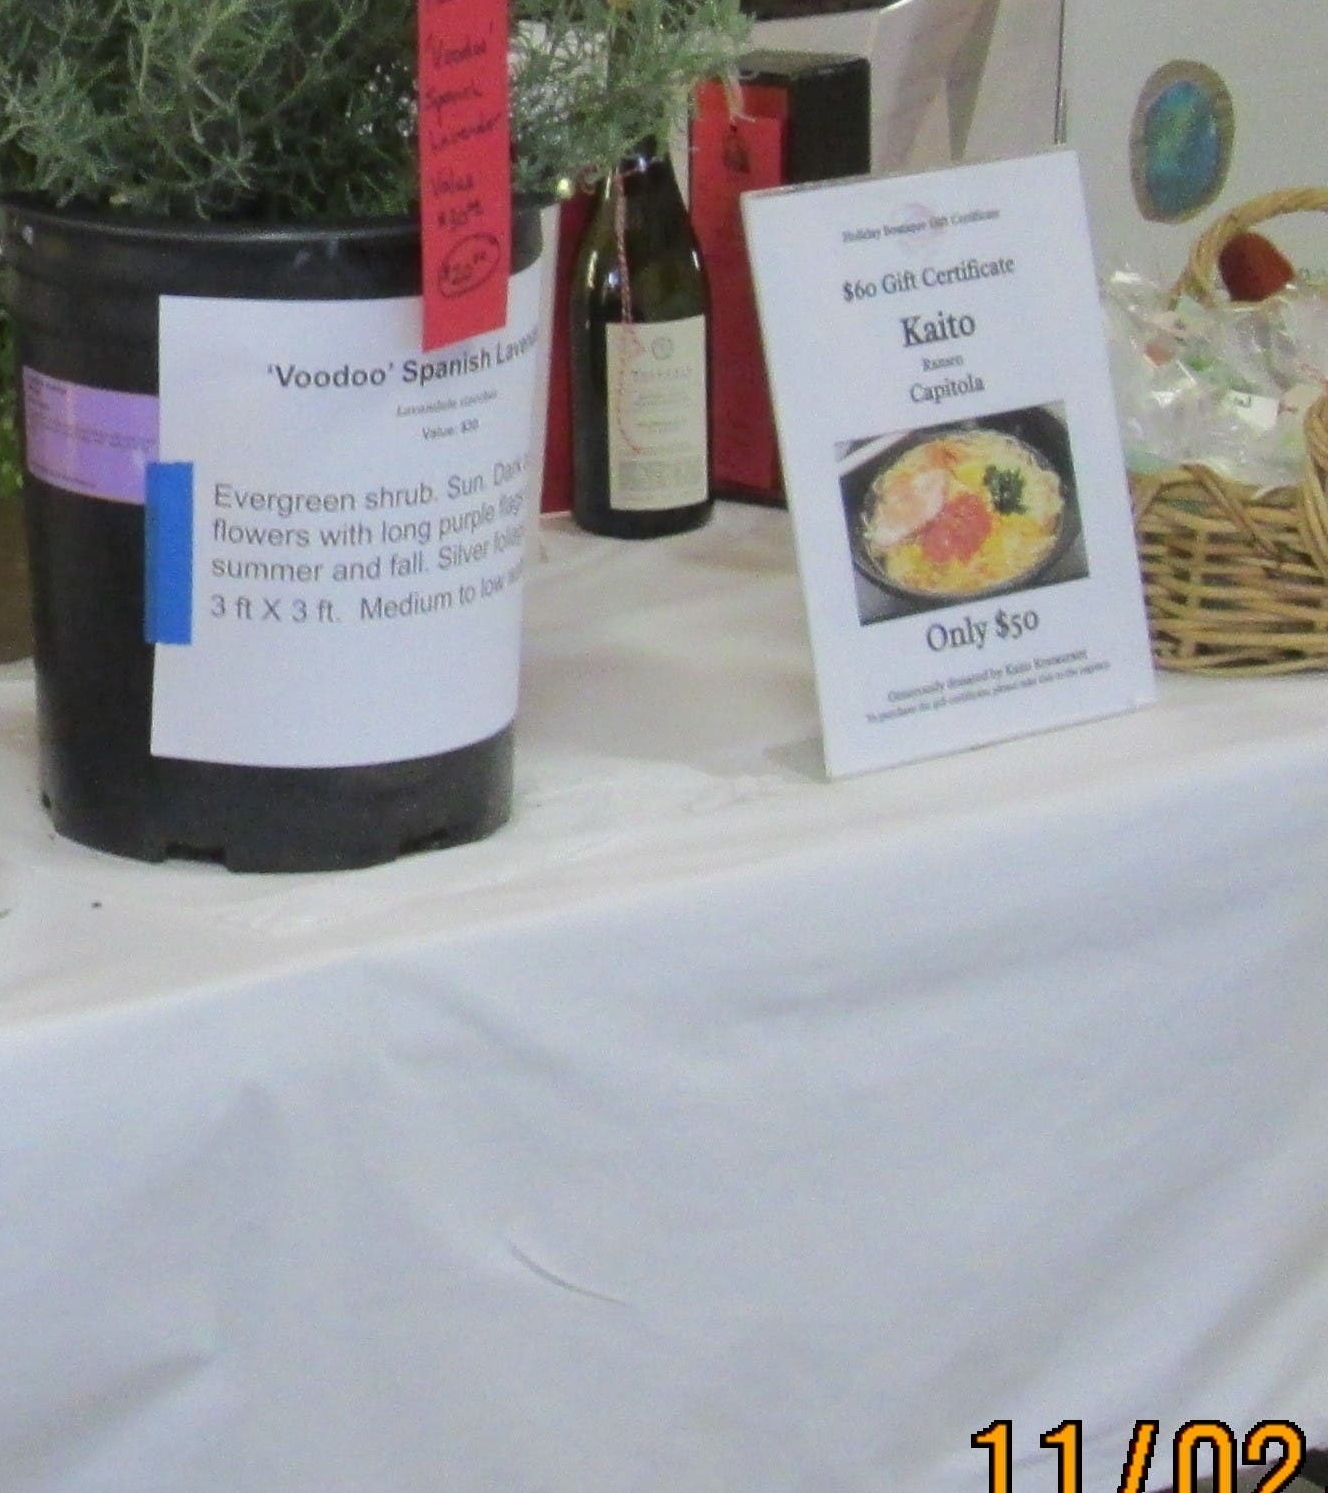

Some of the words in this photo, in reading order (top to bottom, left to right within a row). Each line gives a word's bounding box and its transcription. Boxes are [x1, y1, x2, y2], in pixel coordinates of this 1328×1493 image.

[843, 279, 878, 302] $60
[881, 270, 918, 295] Gift
[921, 257, 1016, 288] Certificate
[900, 310, 976, 348] Kaito
[266, 362, 395, 389] 'Voodoo'
[401, 349, 492, 387] Spanish
[909, 373, 986, 404] Capitola
[214, 481, 357, 519] Evergreen
[364, 481, 439, 508] shrub.
[212, 517, 311, 548] flowers
[319, 520, 373, 547] with
[381, 518, 432, 546] long
[437, 503, 496, 541] purple
[211, 557, 324, 583] summer
[332, 555, 382, 582] and
[390, 553, 429, 576] fall.
[437, 538, 491, 572] Silver
[211, 593, 226, 618] 3
[235, 595, 253, 621] ft
[261, 598, 282, 622] X
[292, 599, 307, 623] 3
[317, 599, 341, 624] ft.
[359, 588, 453, 621] Medium
[457, 584, 477, 605] to
[480, 574, 504, 599] low
[925, 615, 988, 652] Only
[995, 608, 1041, 640] $50
